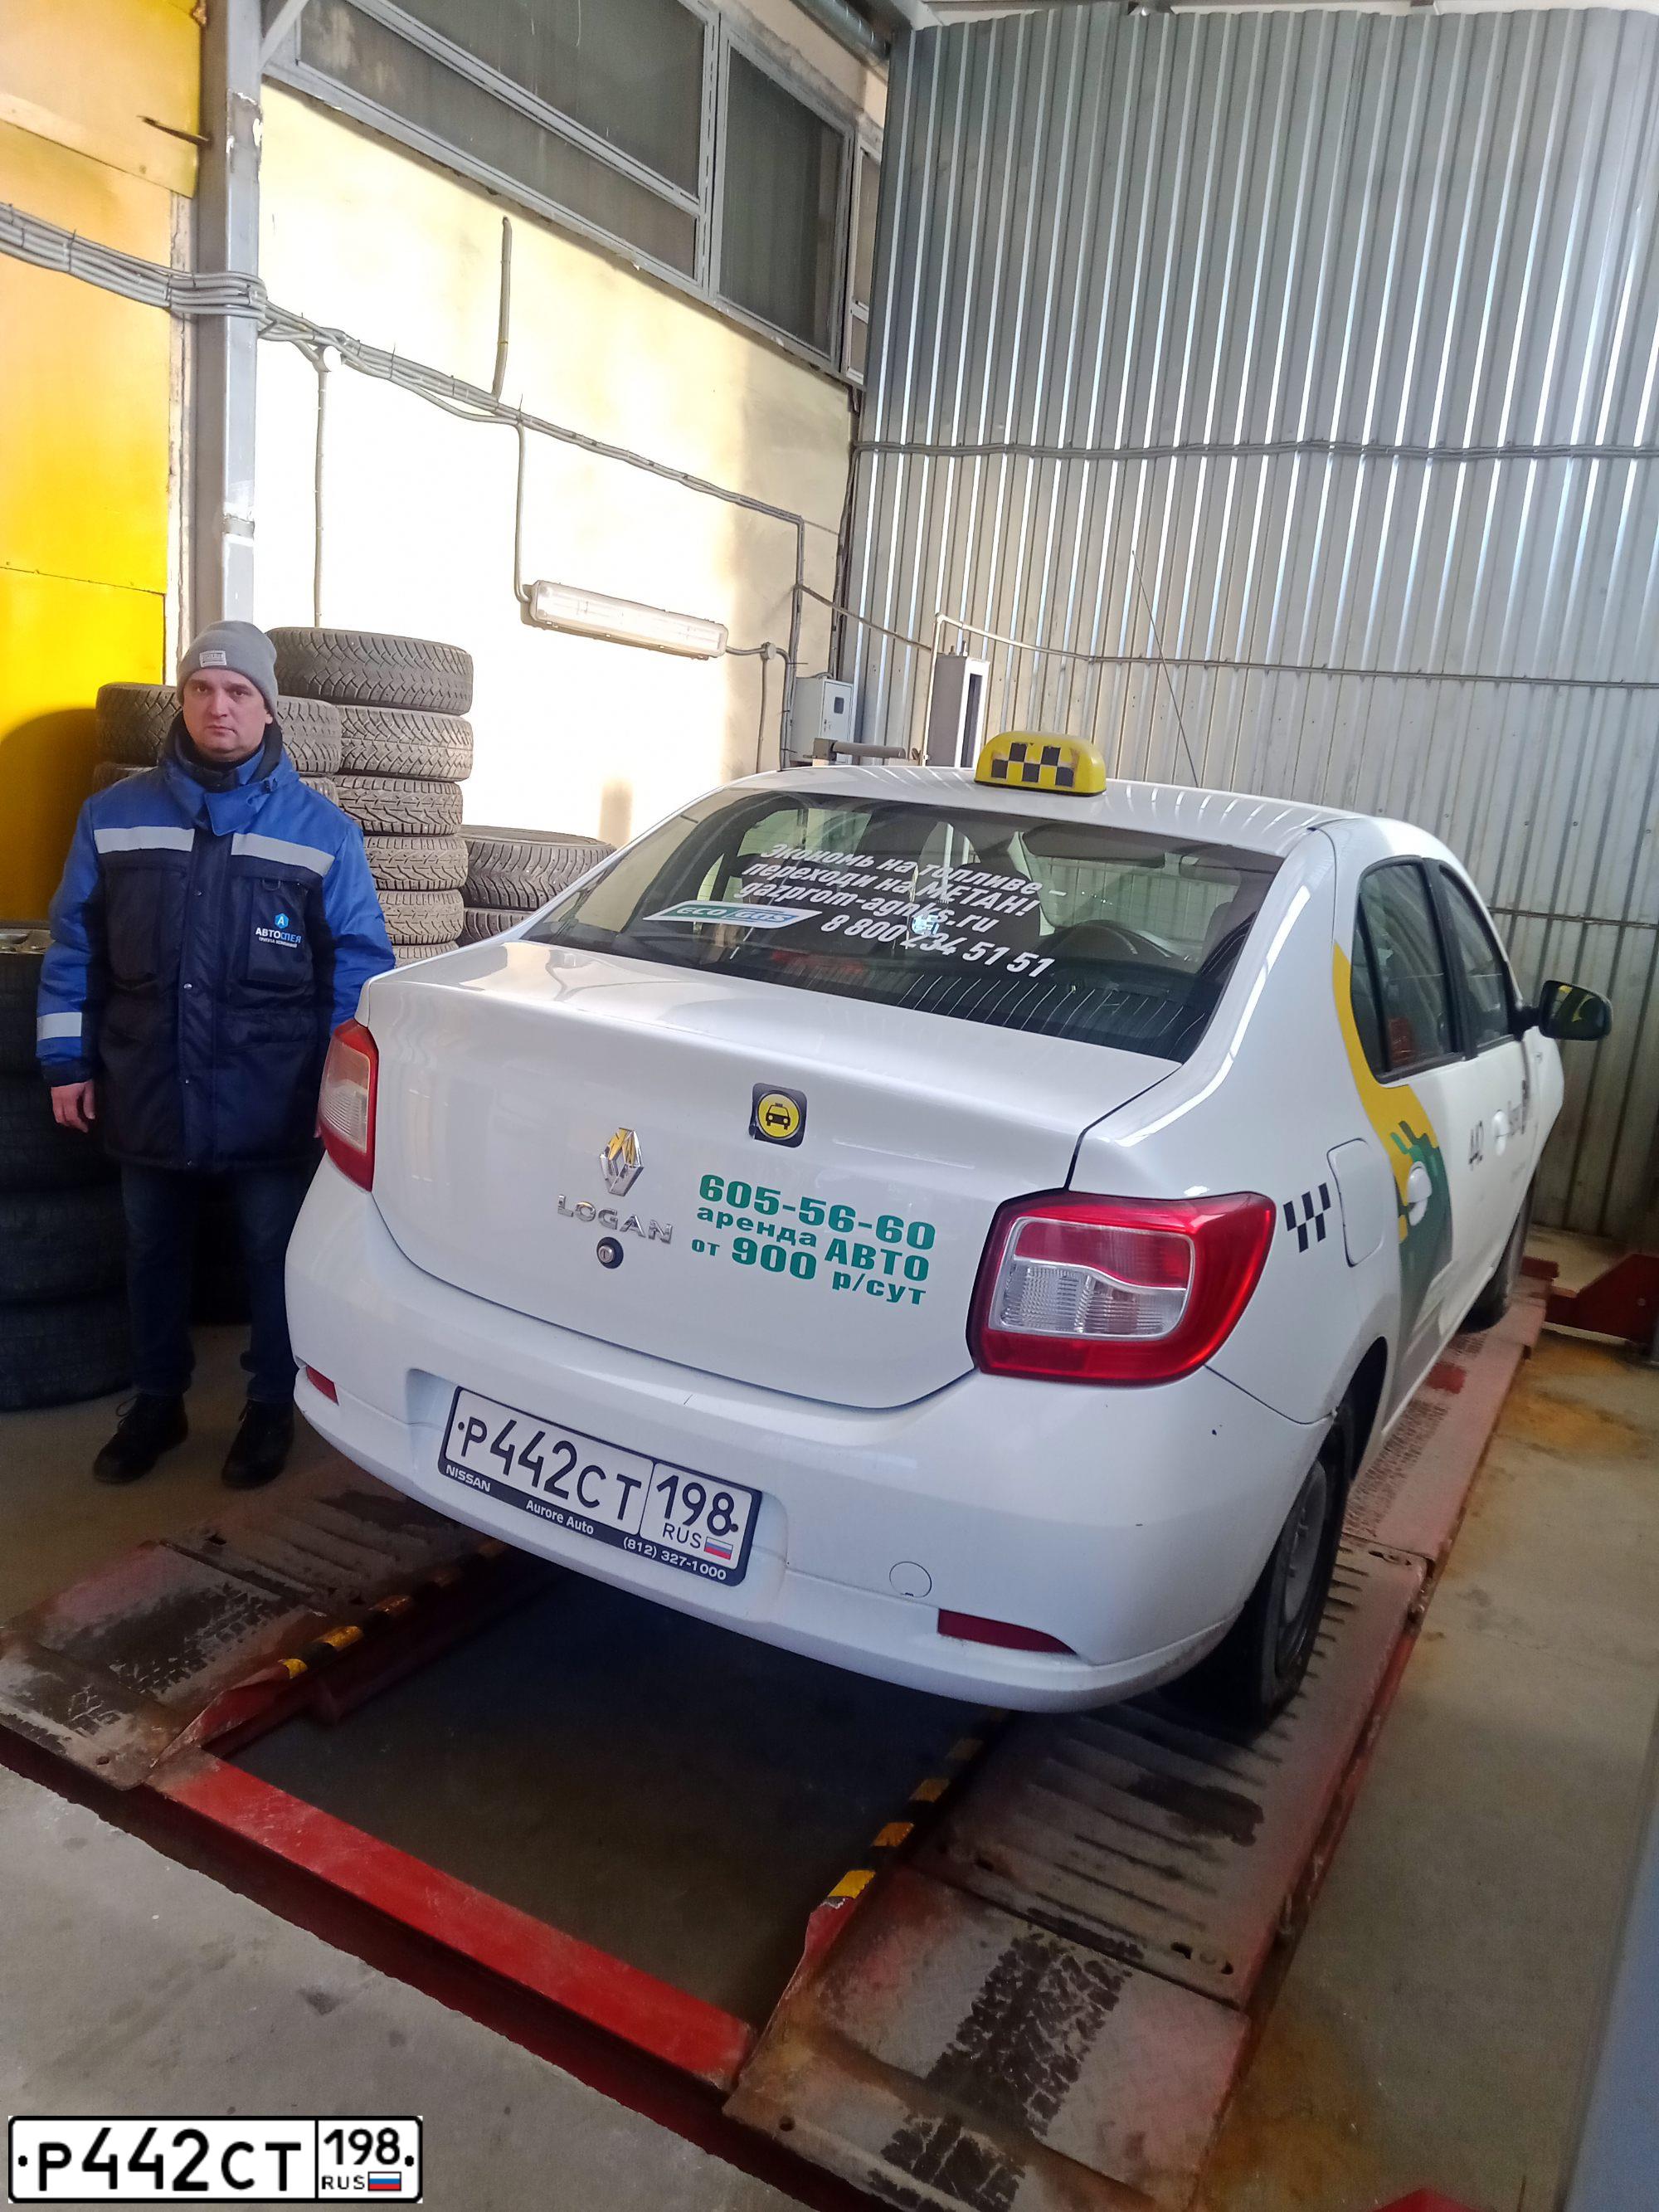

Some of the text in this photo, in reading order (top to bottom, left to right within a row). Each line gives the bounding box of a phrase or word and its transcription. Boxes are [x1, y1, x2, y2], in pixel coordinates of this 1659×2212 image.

[742, 863, 1041, 916] переходи на МЕТАН!
[761, 843, 875, 869] Экономь
[876, 858, 918, 873] на
[918, 864, 1043, 894] топливе
[734, 881, 1000, 933] gazprom-agnks.ru
[820, 914, 850, 932] 8
[844, 918, 907, 943] 800
[962, 941, 1010, 966] 51
[1006, 952, 1055, 977] 51
[557, 1194, 673, 1244] LOGAN
[698, 1174, 937, 1250] 605-56-60
[696, 1206, 930, 1283] аренда АВТО
[691, 1237, 927, 1305] от 900 р/сут
[445, 1464, 491, 1493] NISSAN
[525, 1499, 595, 1535] Aurore Auto
[656, 1474, 735, 1537] 198
[623, 1535, 727, 1581] (812) 327-1000
[663, 1523, 703, 1549] RUS
